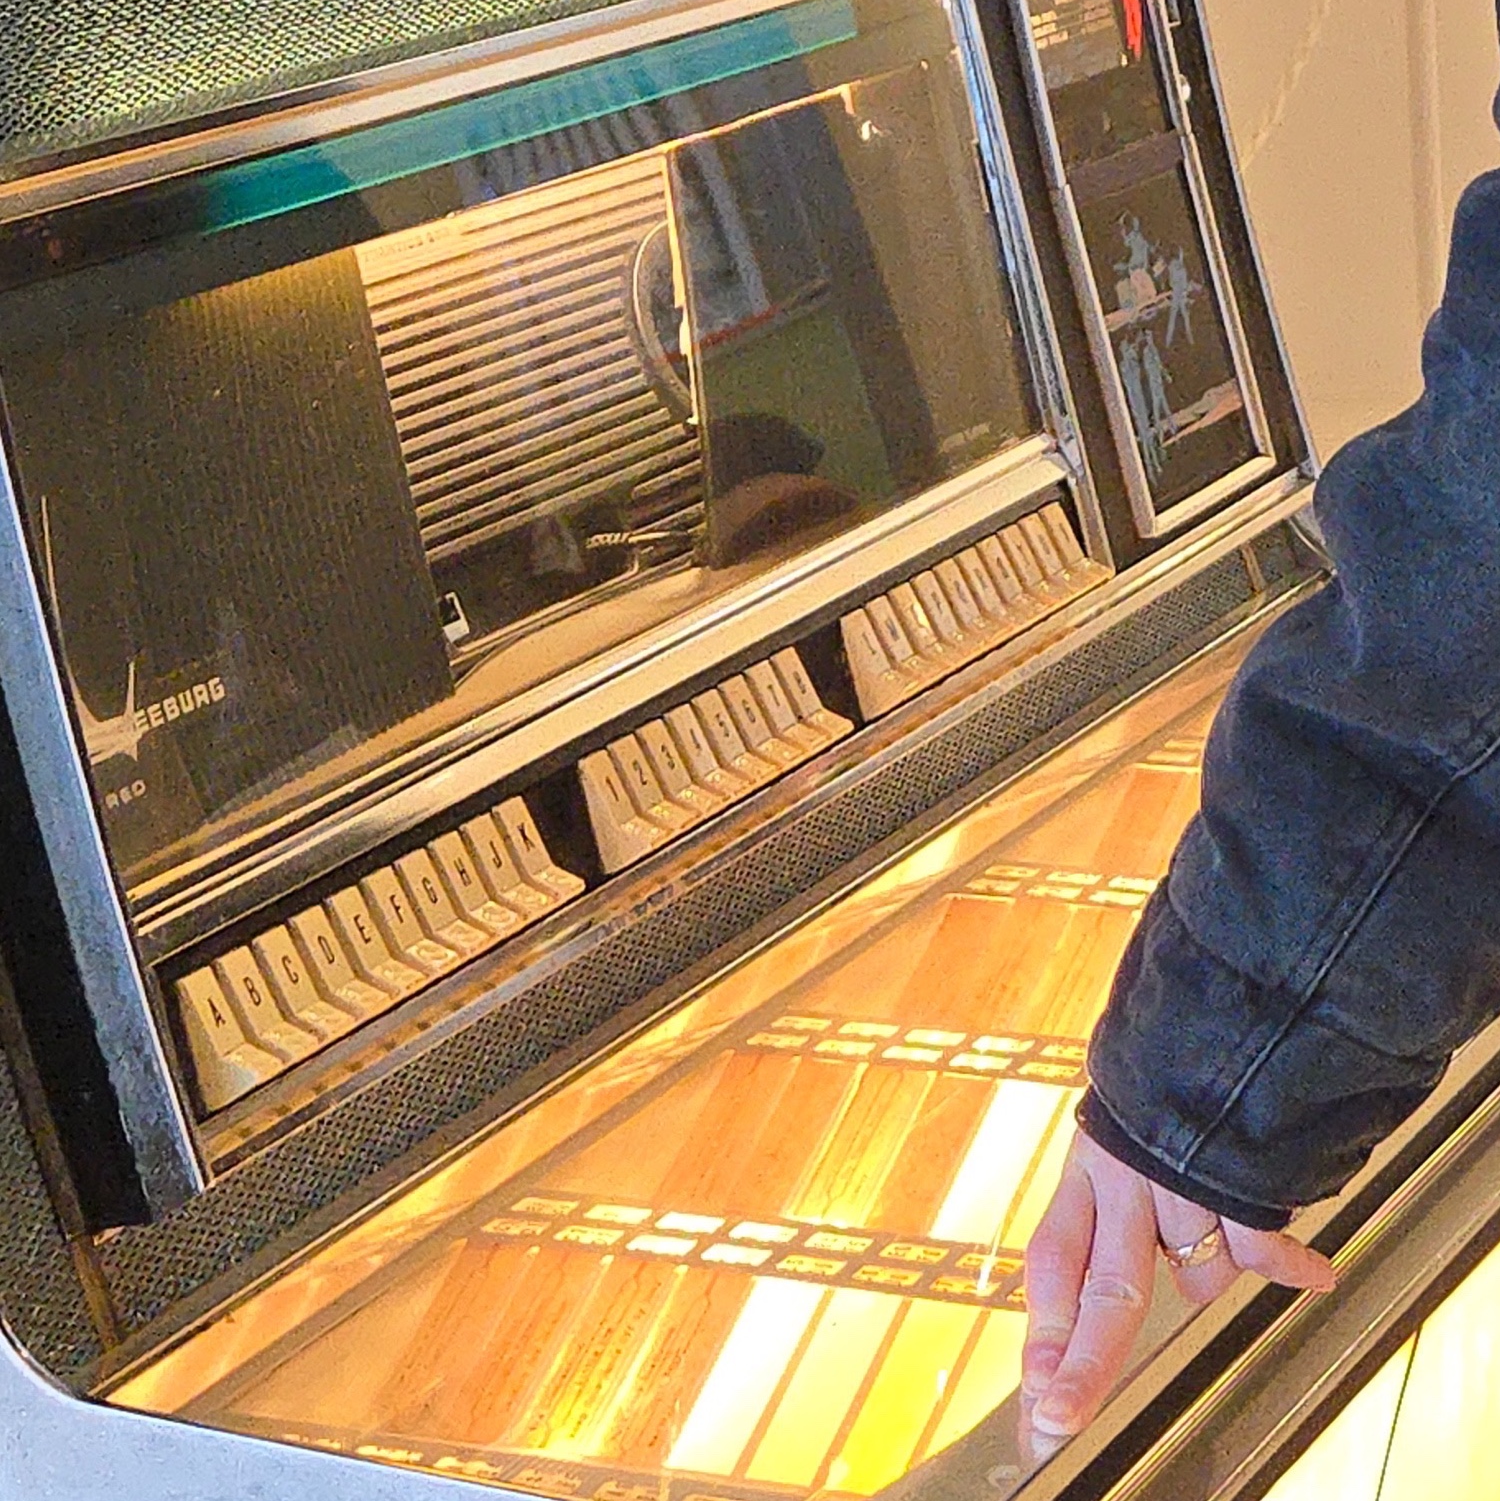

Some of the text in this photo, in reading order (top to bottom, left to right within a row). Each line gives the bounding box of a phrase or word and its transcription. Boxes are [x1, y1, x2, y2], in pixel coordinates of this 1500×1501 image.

[128, 676, 226, 735] EEBURG
[632, 759, 648, 786] 2
[206, 821, 536, 1029] A B C D E F G H J K
